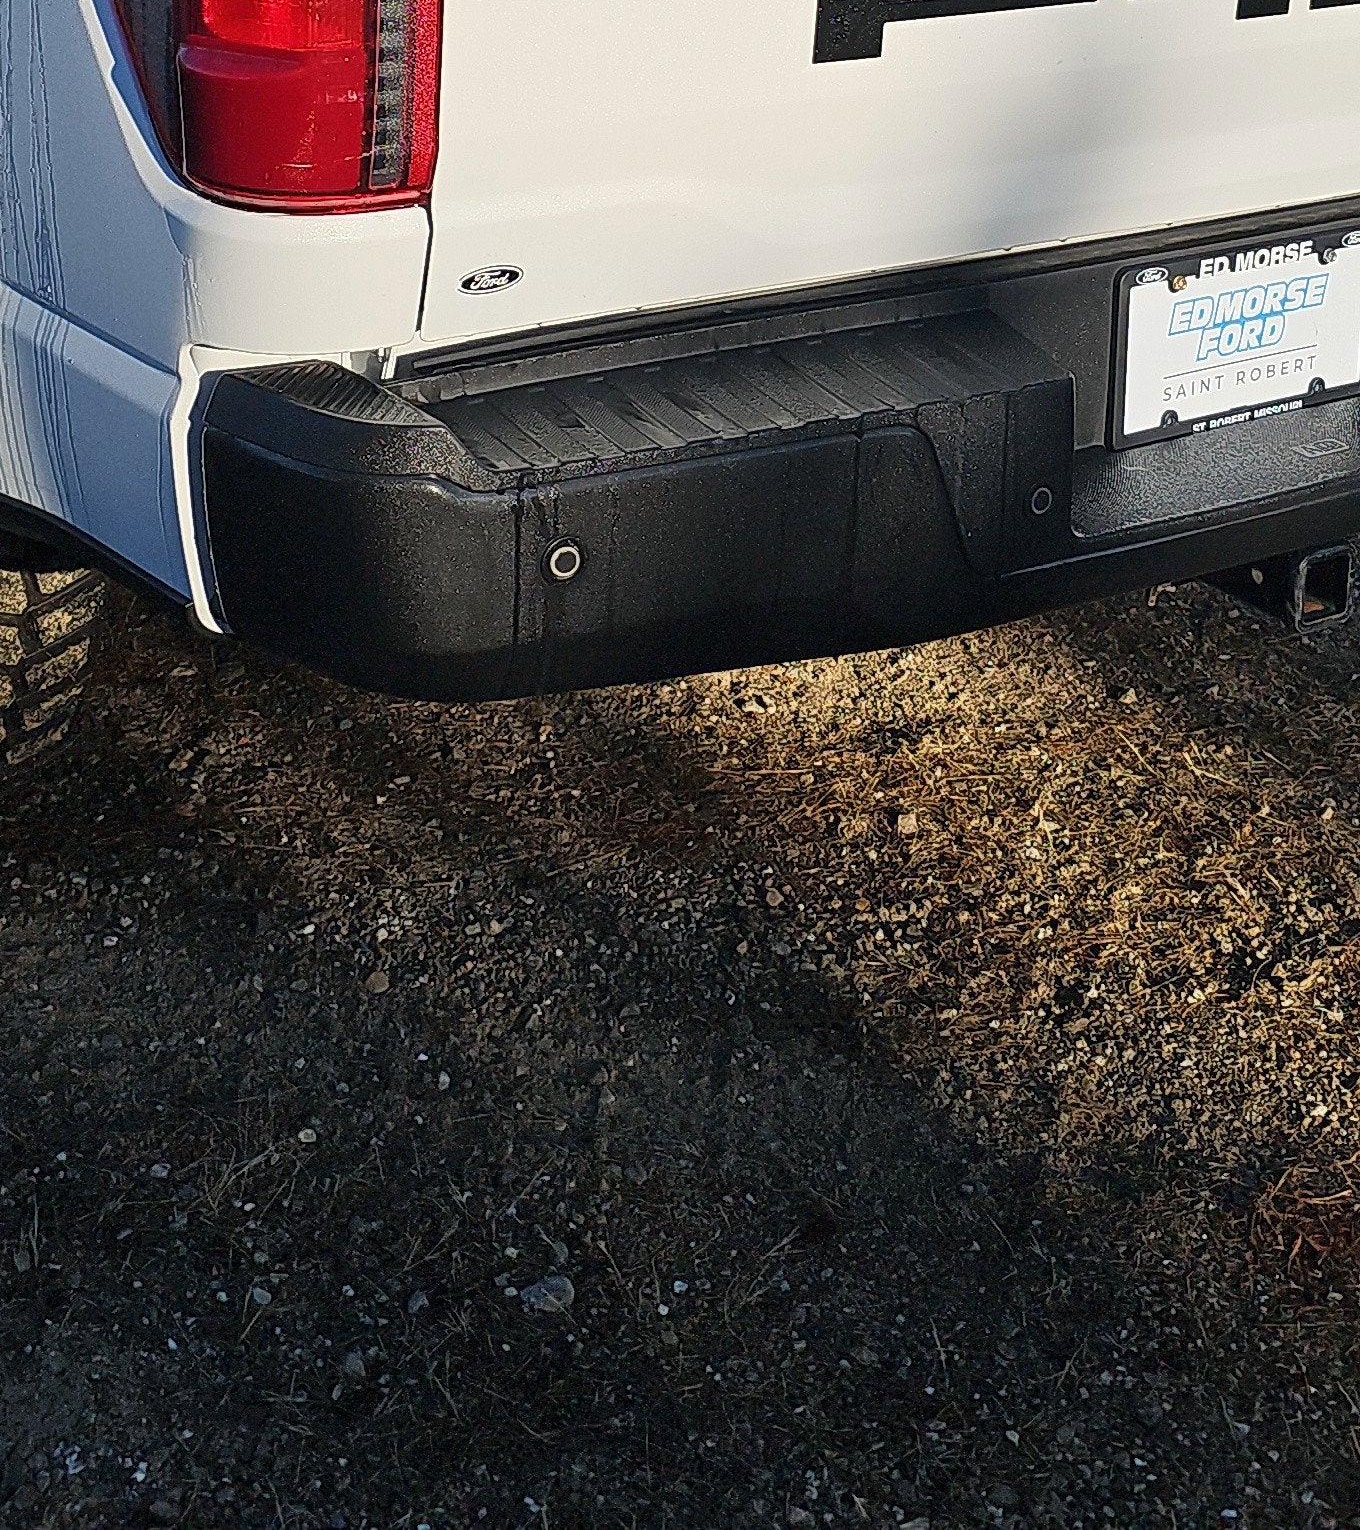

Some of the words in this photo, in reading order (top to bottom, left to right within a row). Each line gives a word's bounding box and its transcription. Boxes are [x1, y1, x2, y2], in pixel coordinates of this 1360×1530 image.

[1199, 256, 1230, 279] ED
[1235, 239, 1314, 272] MORSE
[1196, 315, 1286, 362] FORD
[1162, 375, 1225, 402] SAINT
[1235, 355, 1317, 385] ROBERT
